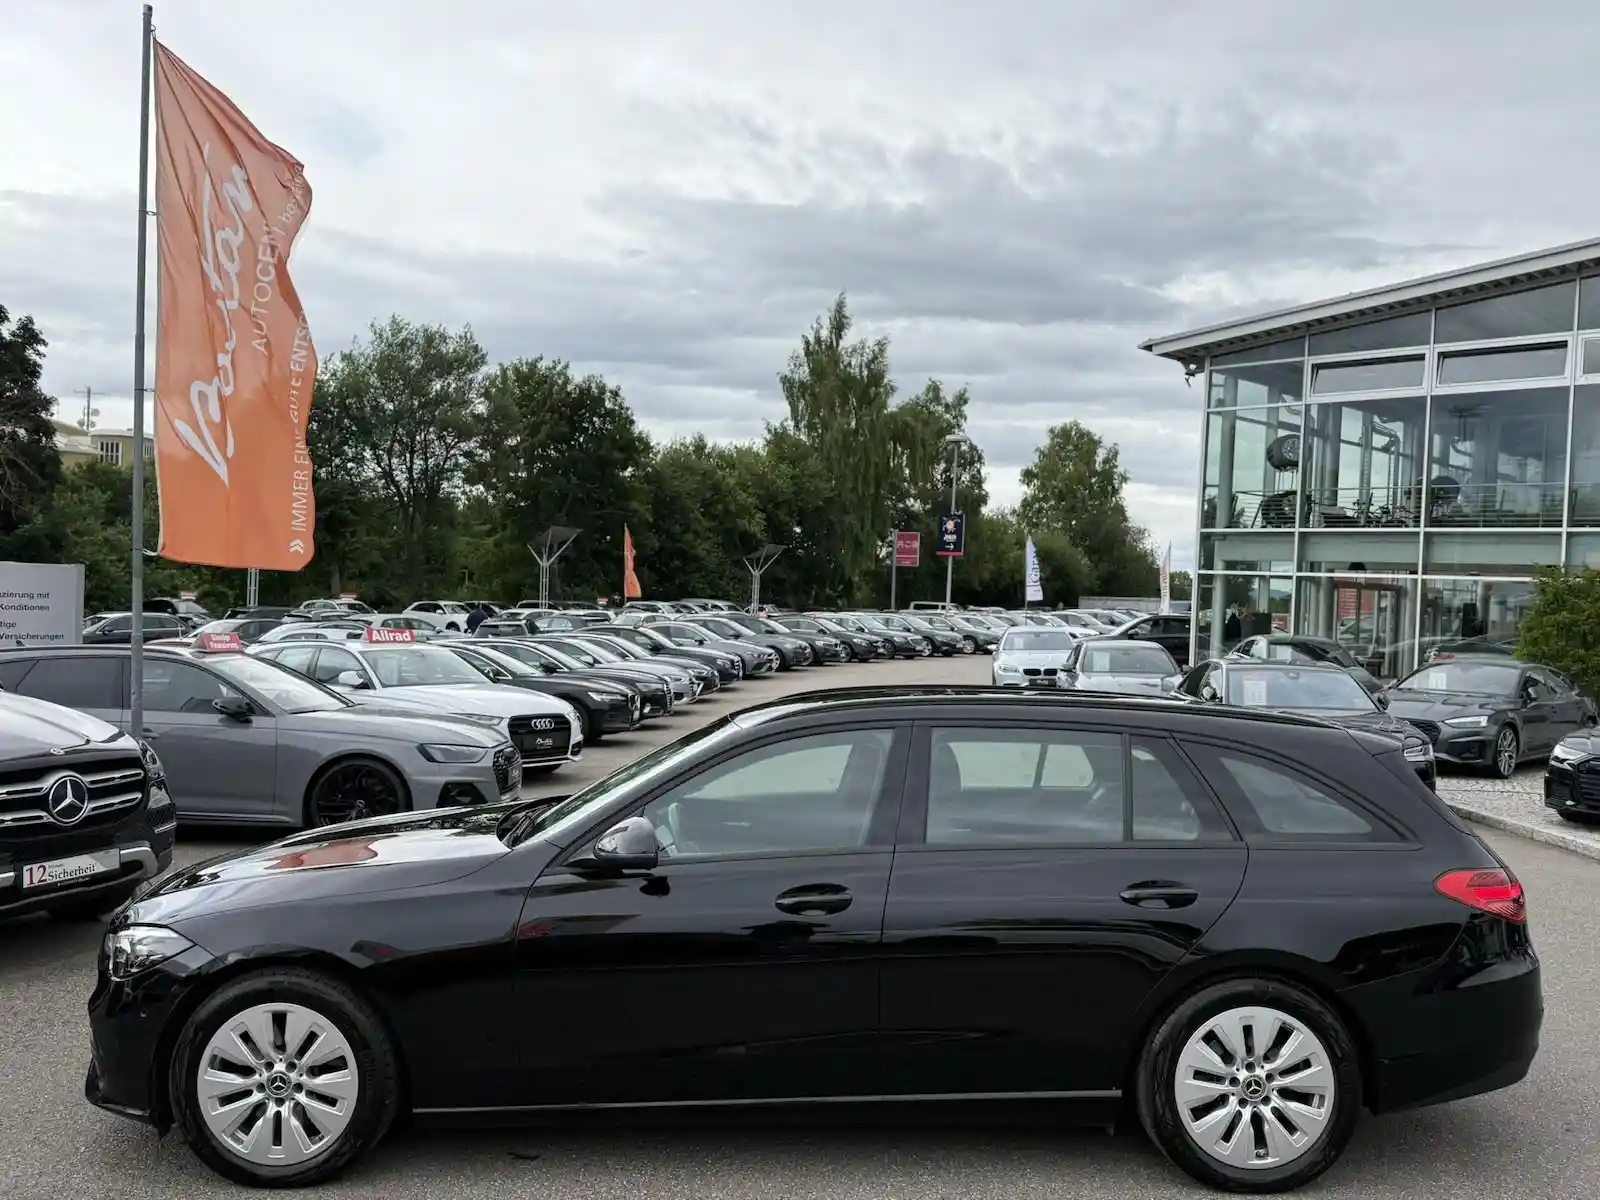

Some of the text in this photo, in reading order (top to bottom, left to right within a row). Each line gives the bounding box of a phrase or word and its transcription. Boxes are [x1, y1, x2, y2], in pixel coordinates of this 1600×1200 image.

[291, 468, 308, 532] IMMER
[0, 591, 35, 600] zierung
[372, 630, 411, 641] Allrad
[25, 864, 47, 886] 12
[48, 863, 97, 880] Sicherheit
